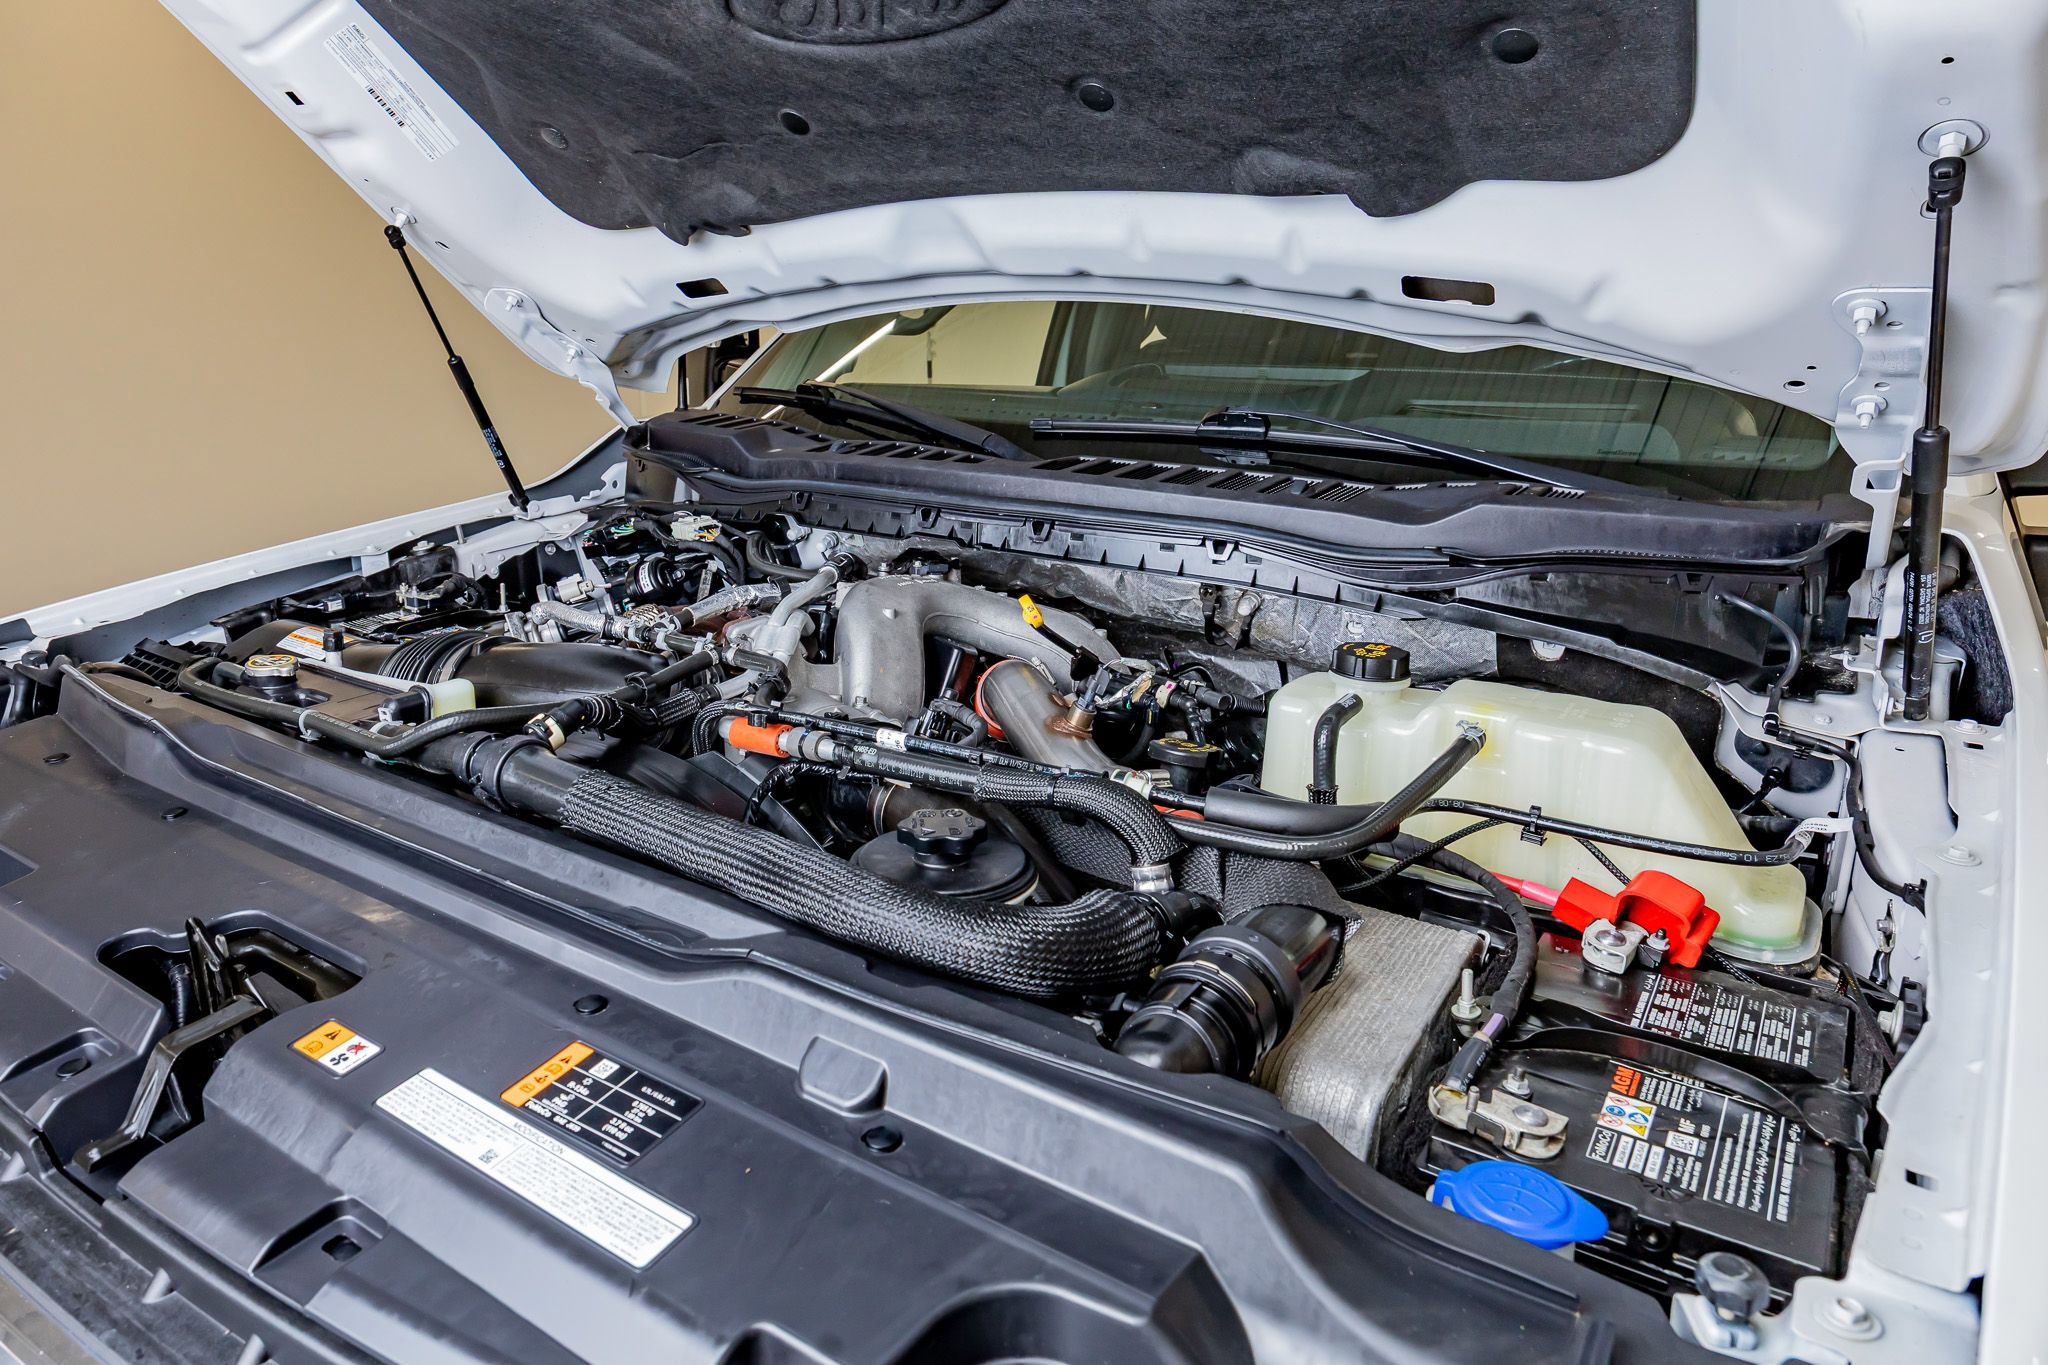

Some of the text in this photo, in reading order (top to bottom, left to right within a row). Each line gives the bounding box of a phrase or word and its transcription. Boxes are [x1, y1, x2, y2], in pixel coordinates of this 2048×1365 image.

[1713, 847, 1759, 863] 10.5mm
[1609, 1064, 1634, 1094] AGM
[1677, 1117, 1697, 1134] MF
[1591, 1128, 1613, 1160] FoMoCo
